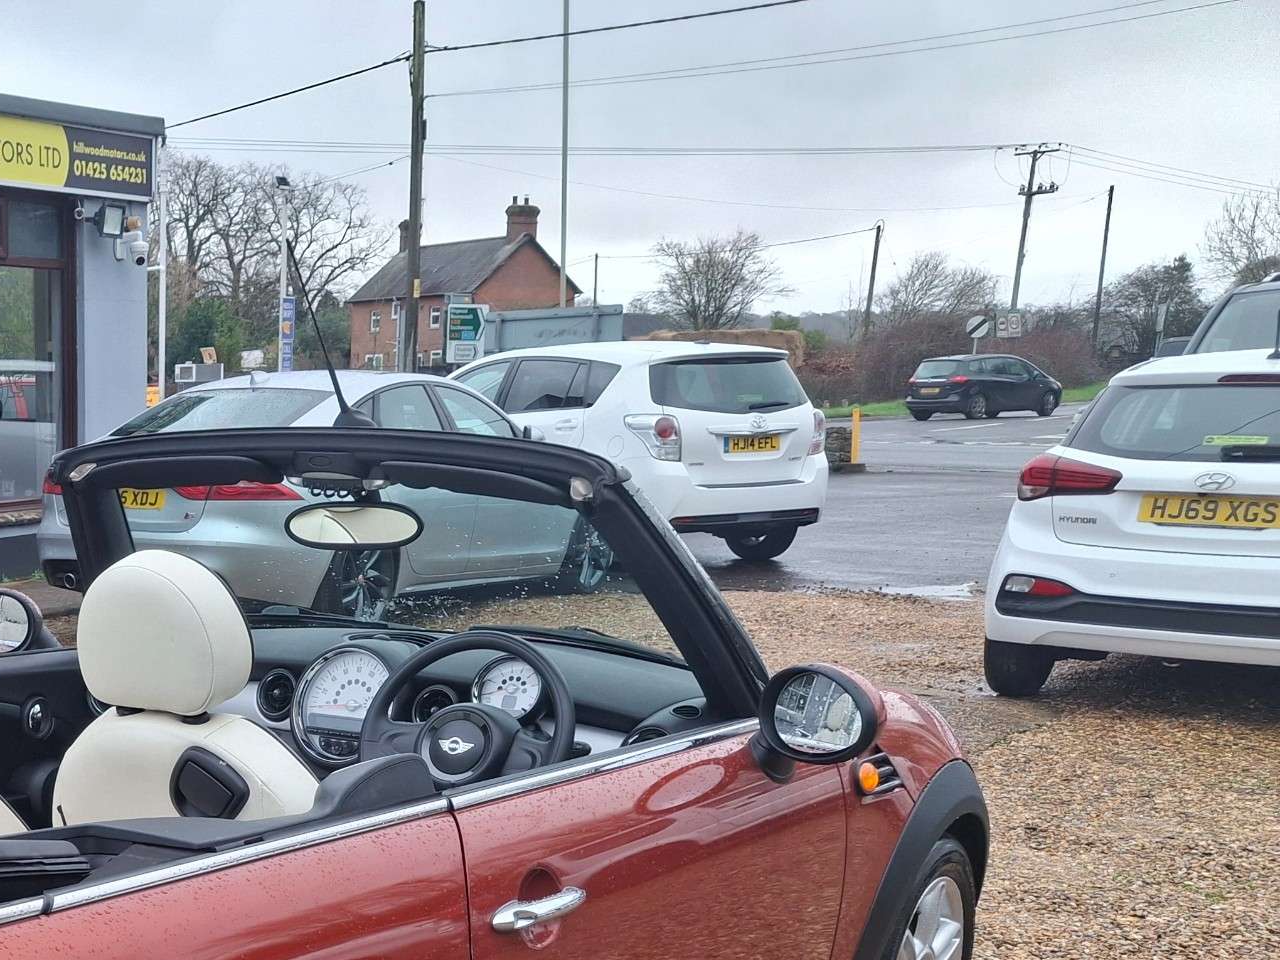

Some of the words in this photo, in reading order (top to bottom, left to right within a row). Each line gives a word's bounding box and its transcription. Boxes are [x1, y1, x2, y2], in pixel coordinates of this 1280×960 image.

[39, 145, 62, 169] LTD
[73, 140, 146, 162] hillwoodmotors.co.uk
[73, 159, 107, 179] 01425
[110, 165, 147, 184] 654231
[732, 437, 755, 451] HJ14
[757, 436, 776, 449] EFL
[130, 490, 159, 506] XDJ
[1058, 515, 1097, 525] HYUNDAI
[1150, 497, 1219, 521] HJ69
[1223, 500, 1279, 524] XGS
